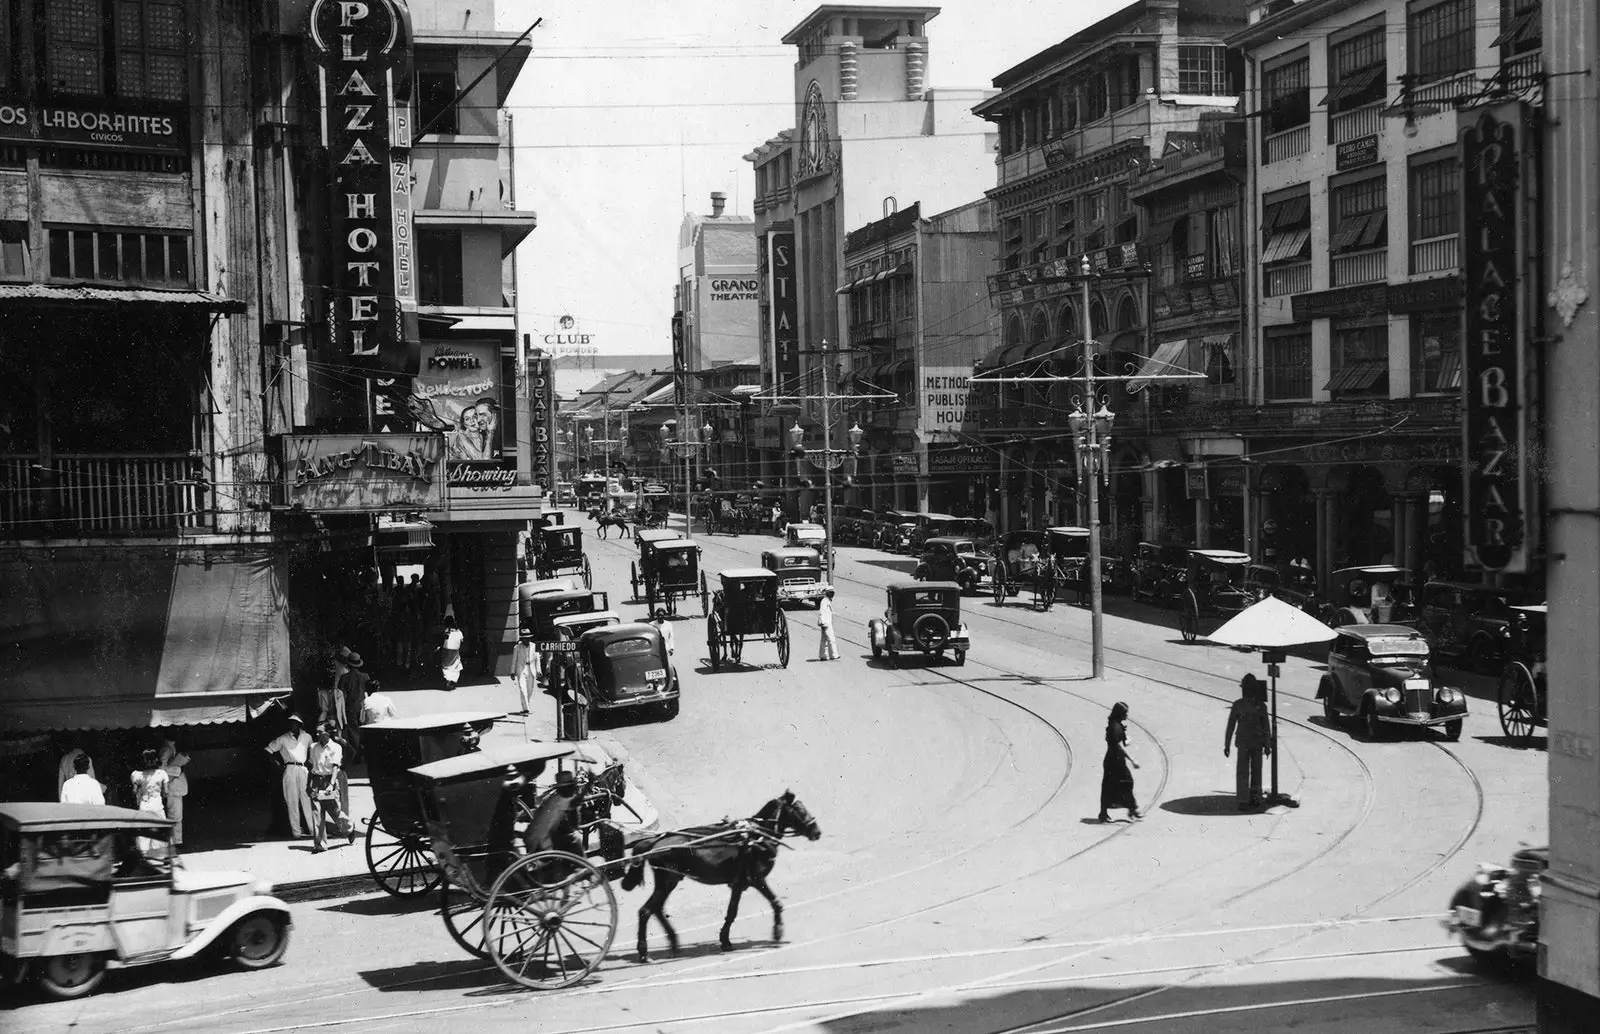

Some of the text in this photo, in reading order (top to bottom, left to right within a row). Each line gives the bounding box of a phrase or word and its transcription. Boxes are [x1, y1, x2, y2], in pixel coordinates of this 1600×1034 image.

[43, 109, 173, 136] LABORANTES
[90, 132, 123, 142] CIVICOS
[336, 1, 382, 356] PLAZA HOTEL
[394, 117, 411, 294] PLZA HOTEL
[710, 292, 758, 301] THEATRE
[711, 279, 758, 292] GRAND
[776, 245, 791, 396] STATE
[1477, 143, 1508, 546] PALACE BAZAR
[428, 356, 482, 370] POWELL
[534, 358, 549, 490] IDEAL BAZAR
[937, 411, 980, 424] HOUSE
[295, 440, 435, 487] ANG TIBAY
[450, 463, 518, 485] Showing
[540, 642, 576, 651] CARRIEDO
